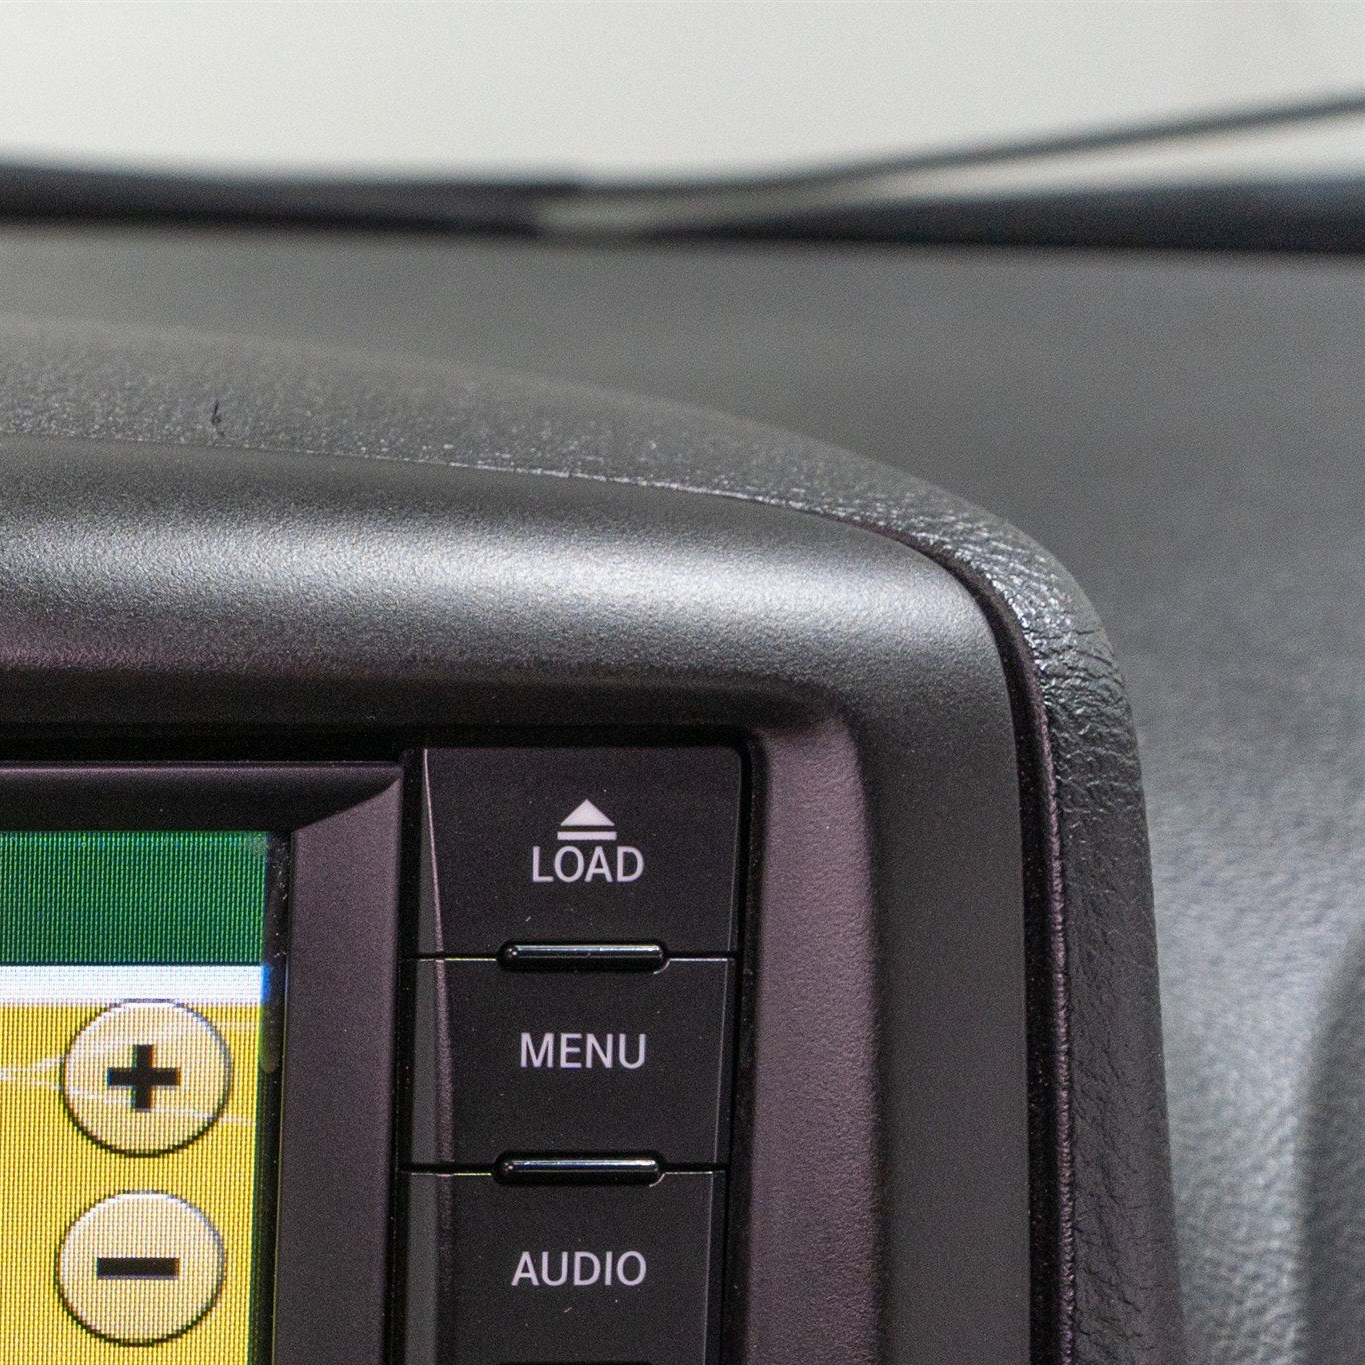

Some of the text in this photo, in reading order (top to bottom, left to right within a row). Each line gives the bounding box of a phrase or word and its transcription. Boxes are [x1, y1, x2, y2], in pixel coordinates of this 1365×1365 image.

[531, 844, 644, 884] LOAD
[519, 1032, 648, 1069] MENU
[511, 1251, 648, 1287] AUDIO
